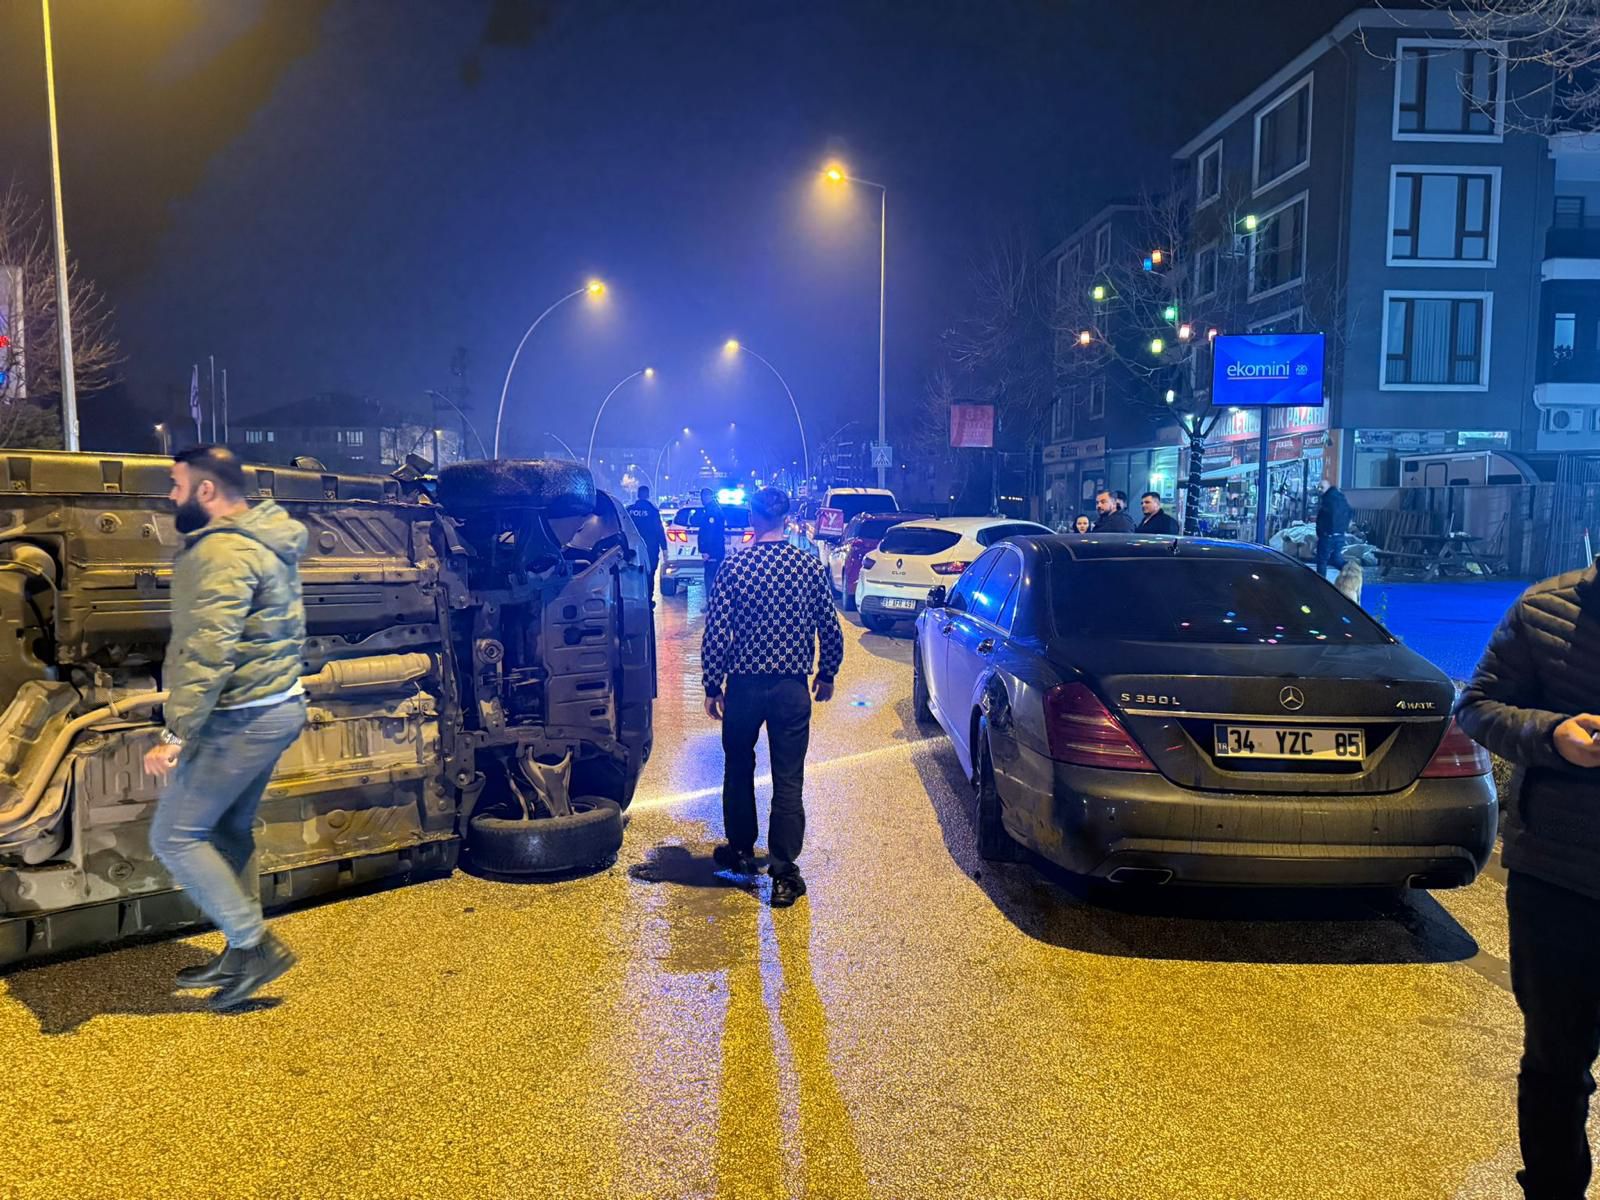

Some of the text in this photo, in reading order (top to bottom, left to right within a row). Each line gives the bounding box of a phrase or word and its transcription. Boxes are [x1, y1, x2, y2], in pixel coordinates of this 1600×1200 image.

[1227, 361, 1290, 376] ekomini
[1121, 693, 1130, 702] S
[1229, 729, 1255, 753] 34
[1275, 730, 1313, 755] YZC
[1335, 732, 1361, 757] 85
